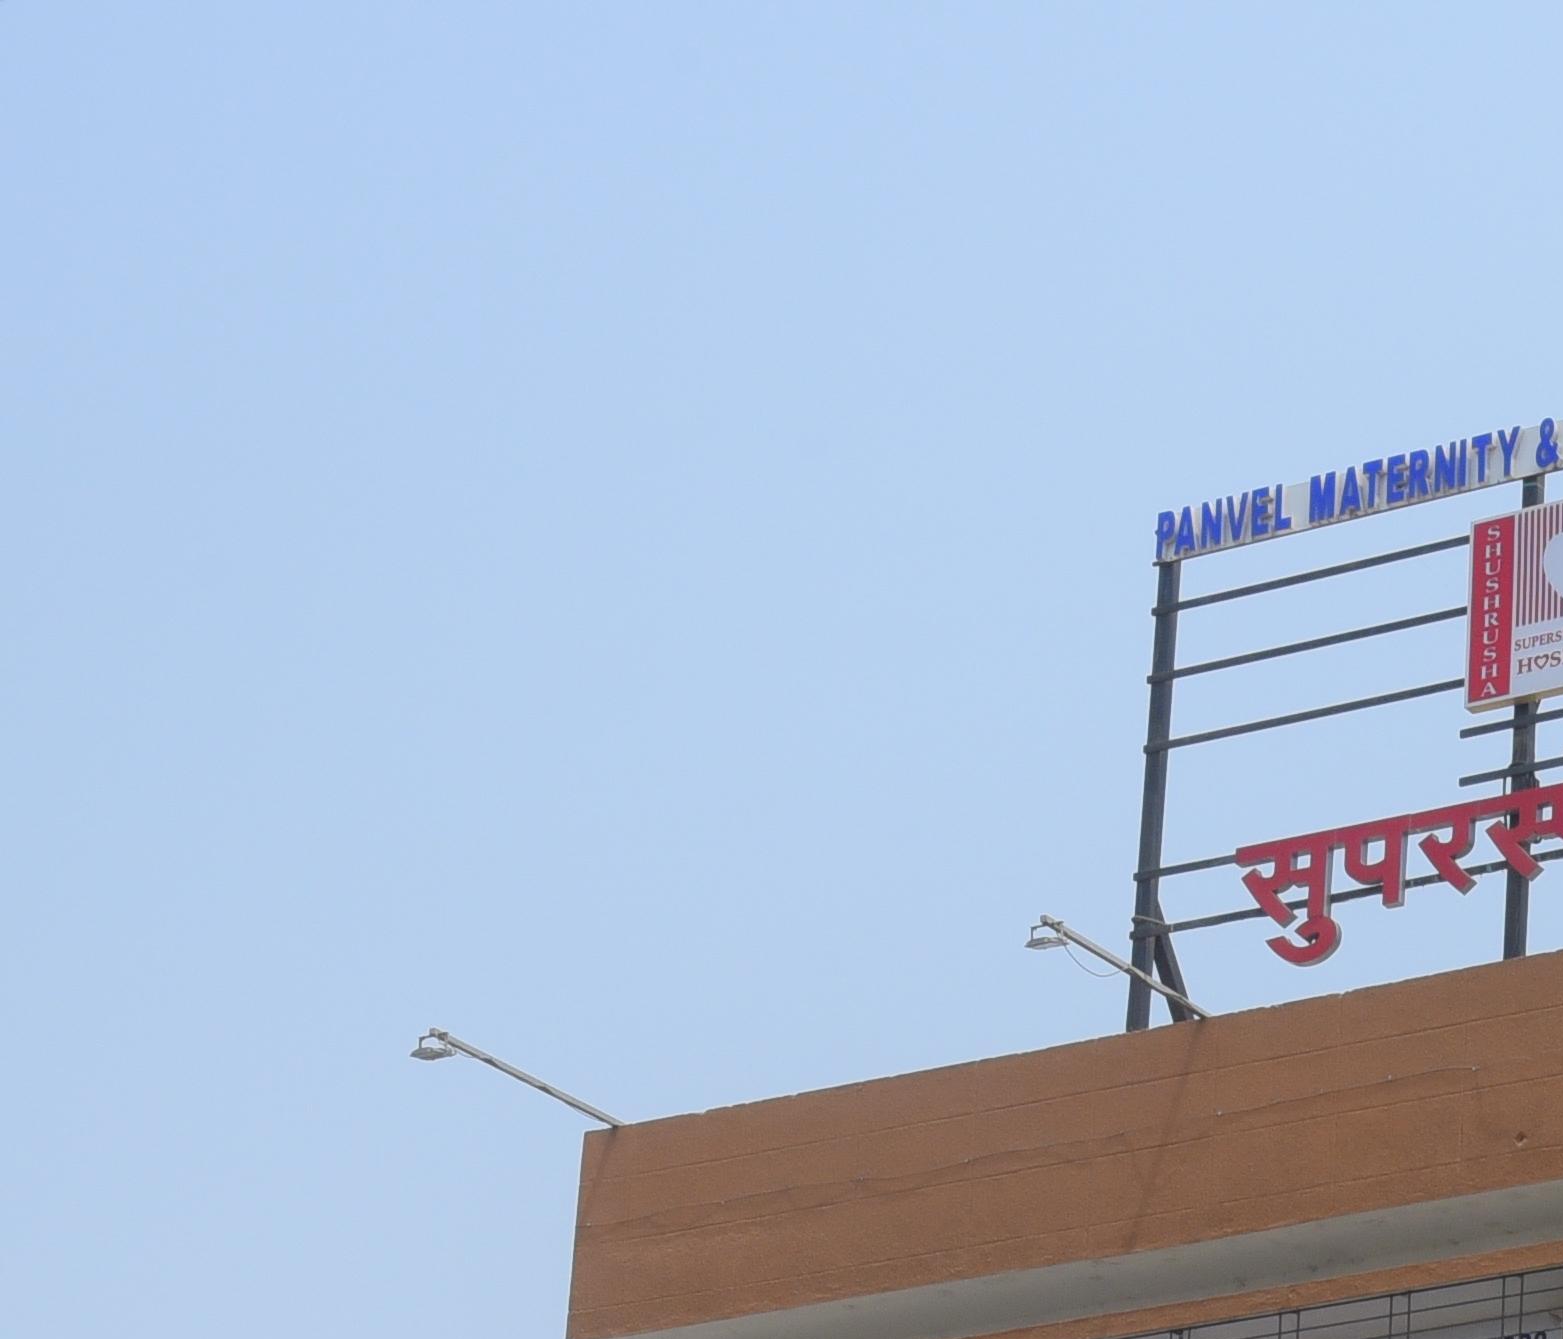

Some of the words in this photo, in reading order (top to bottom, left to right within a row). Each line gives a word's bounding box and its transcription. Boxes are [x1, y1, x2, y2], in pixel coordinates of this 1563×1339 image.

[1156, 484, 1292, 560] PANVEL
[1309, 425, 1520, 523] MATERNITY
[1536, 418, 1559, 469] &
[1481, 525, 1501, 697] SHUSHRUSHA
